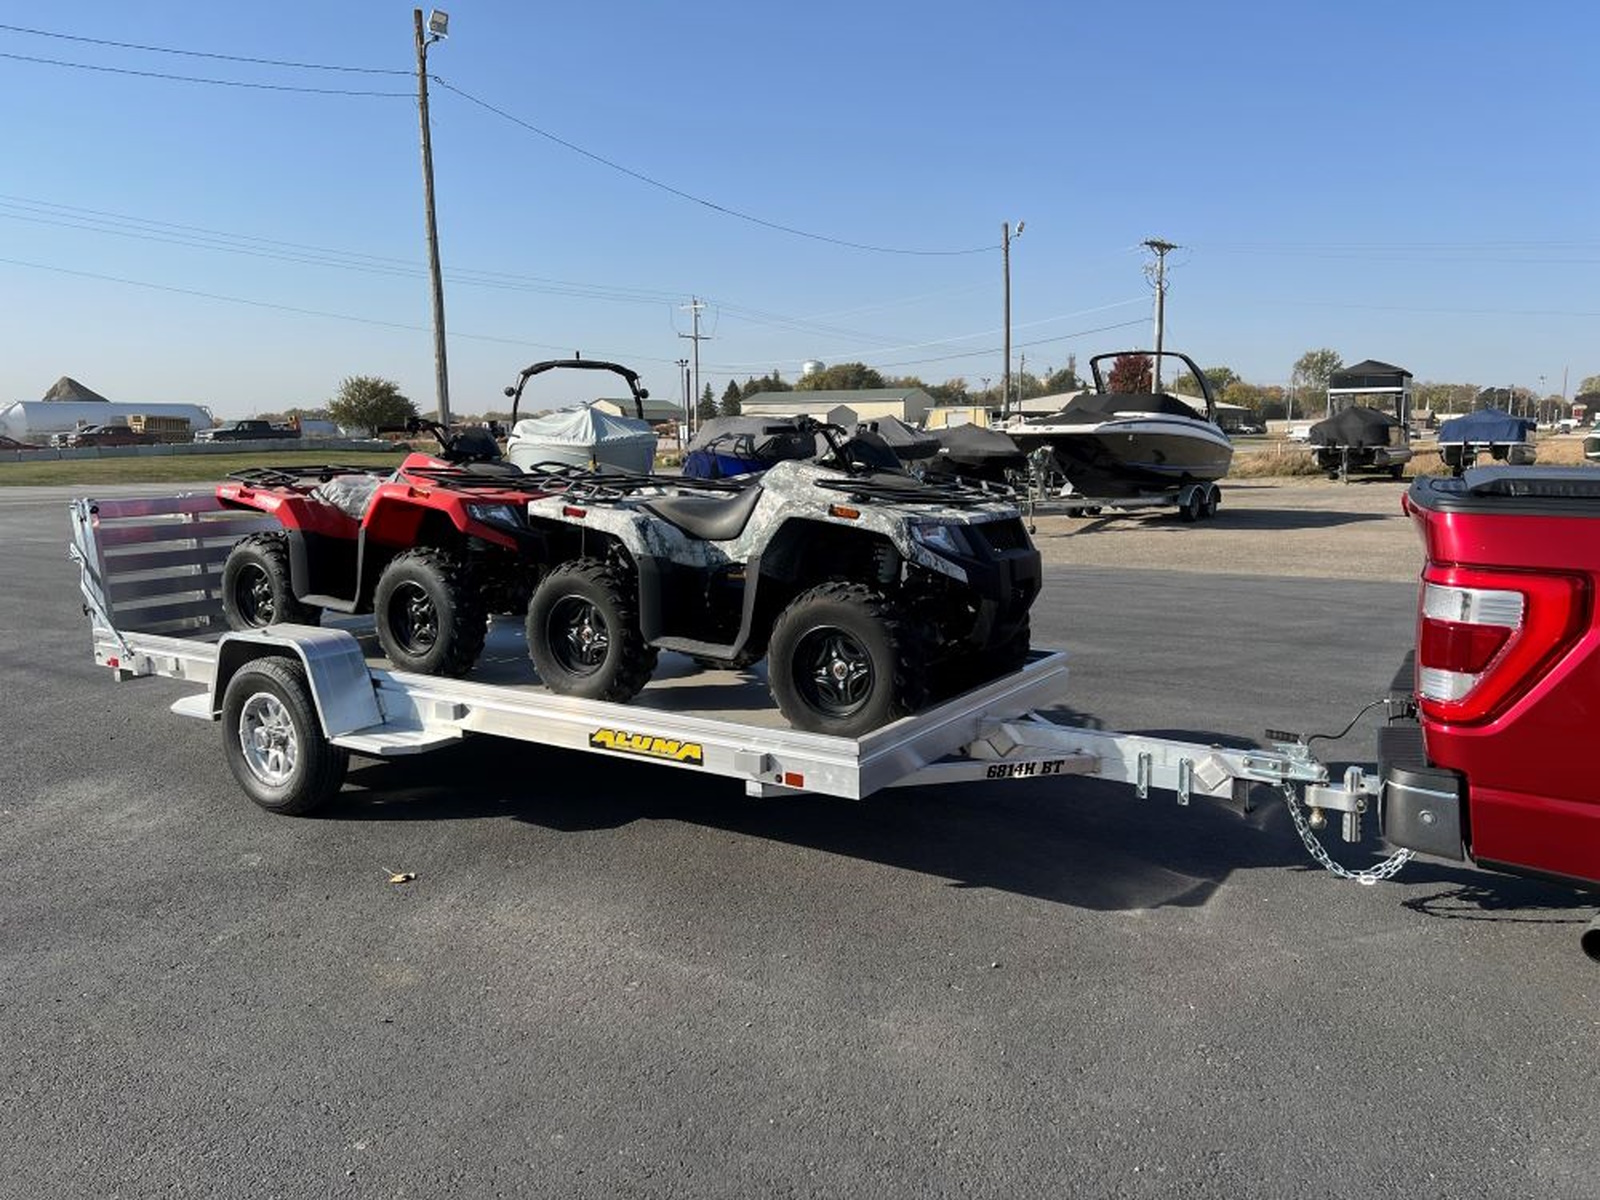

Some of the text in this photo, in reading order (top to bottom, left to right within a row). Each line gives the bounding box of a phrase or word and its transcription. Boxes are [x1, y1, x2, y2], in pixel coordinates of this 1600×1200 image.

[590, 727, 703, 763] ALUMA
[986, 759, 1065, 778] 6814H BT
